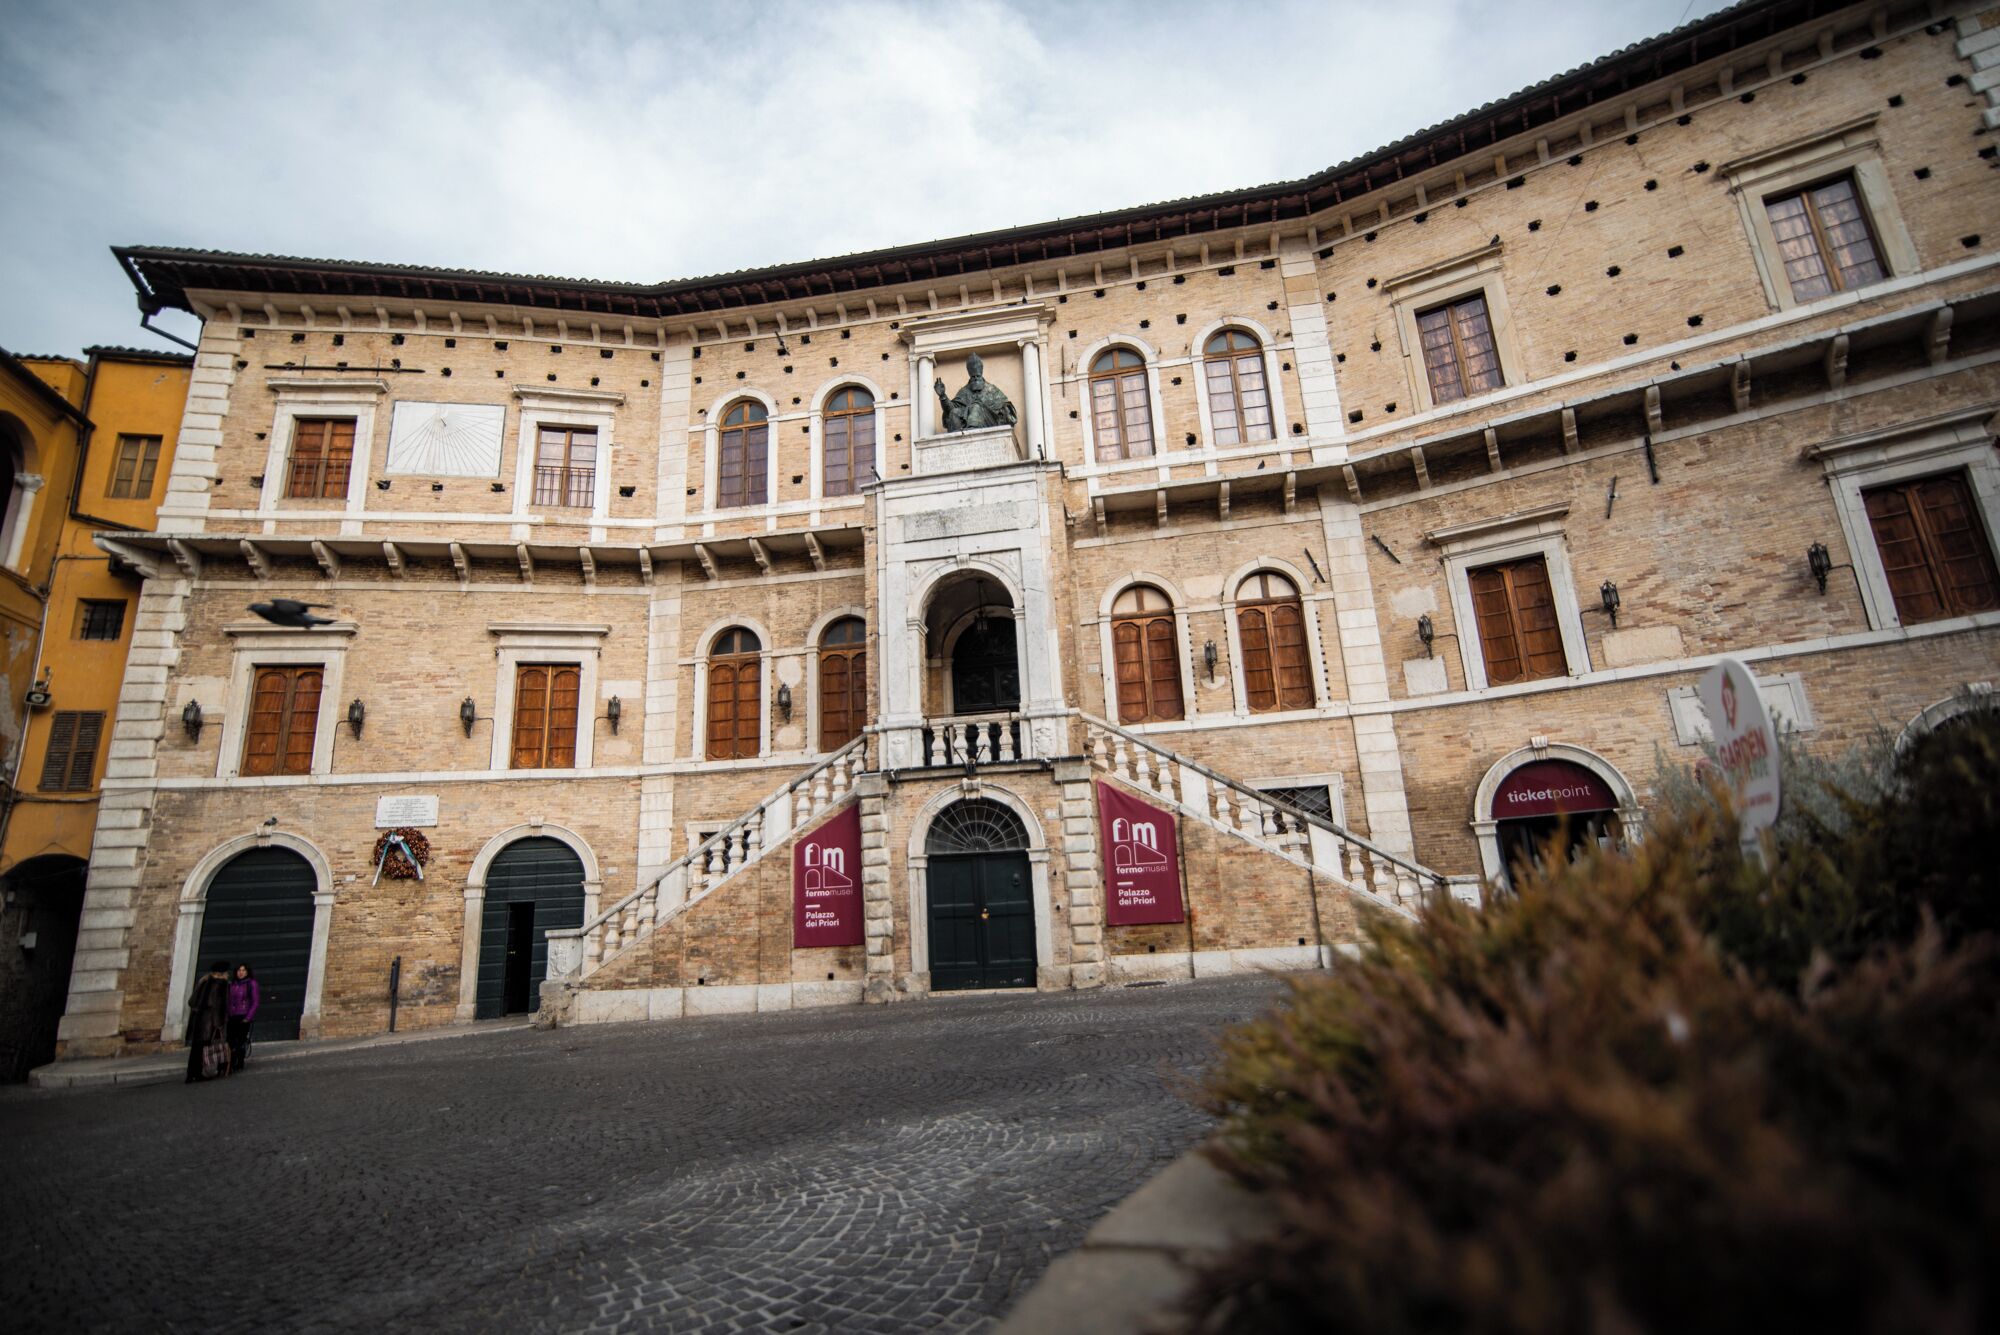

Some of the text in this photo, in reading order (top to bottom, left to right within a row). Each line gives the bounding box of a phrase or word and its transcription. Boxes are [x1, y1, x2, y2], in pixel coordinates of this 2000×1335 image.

[1507, 785, 1591, 803] ticketpoint
[1116, 865, 1168, 875] fermomusei
[805, 888, 853, 898] fermomusei
[1118, 888, 1150, 897] Palazzo
[1119, 896, 1156, 906] dei Priori
[805, 910, 835, 919] Palazzo
[805, 918, 840, 928] dei Priori
